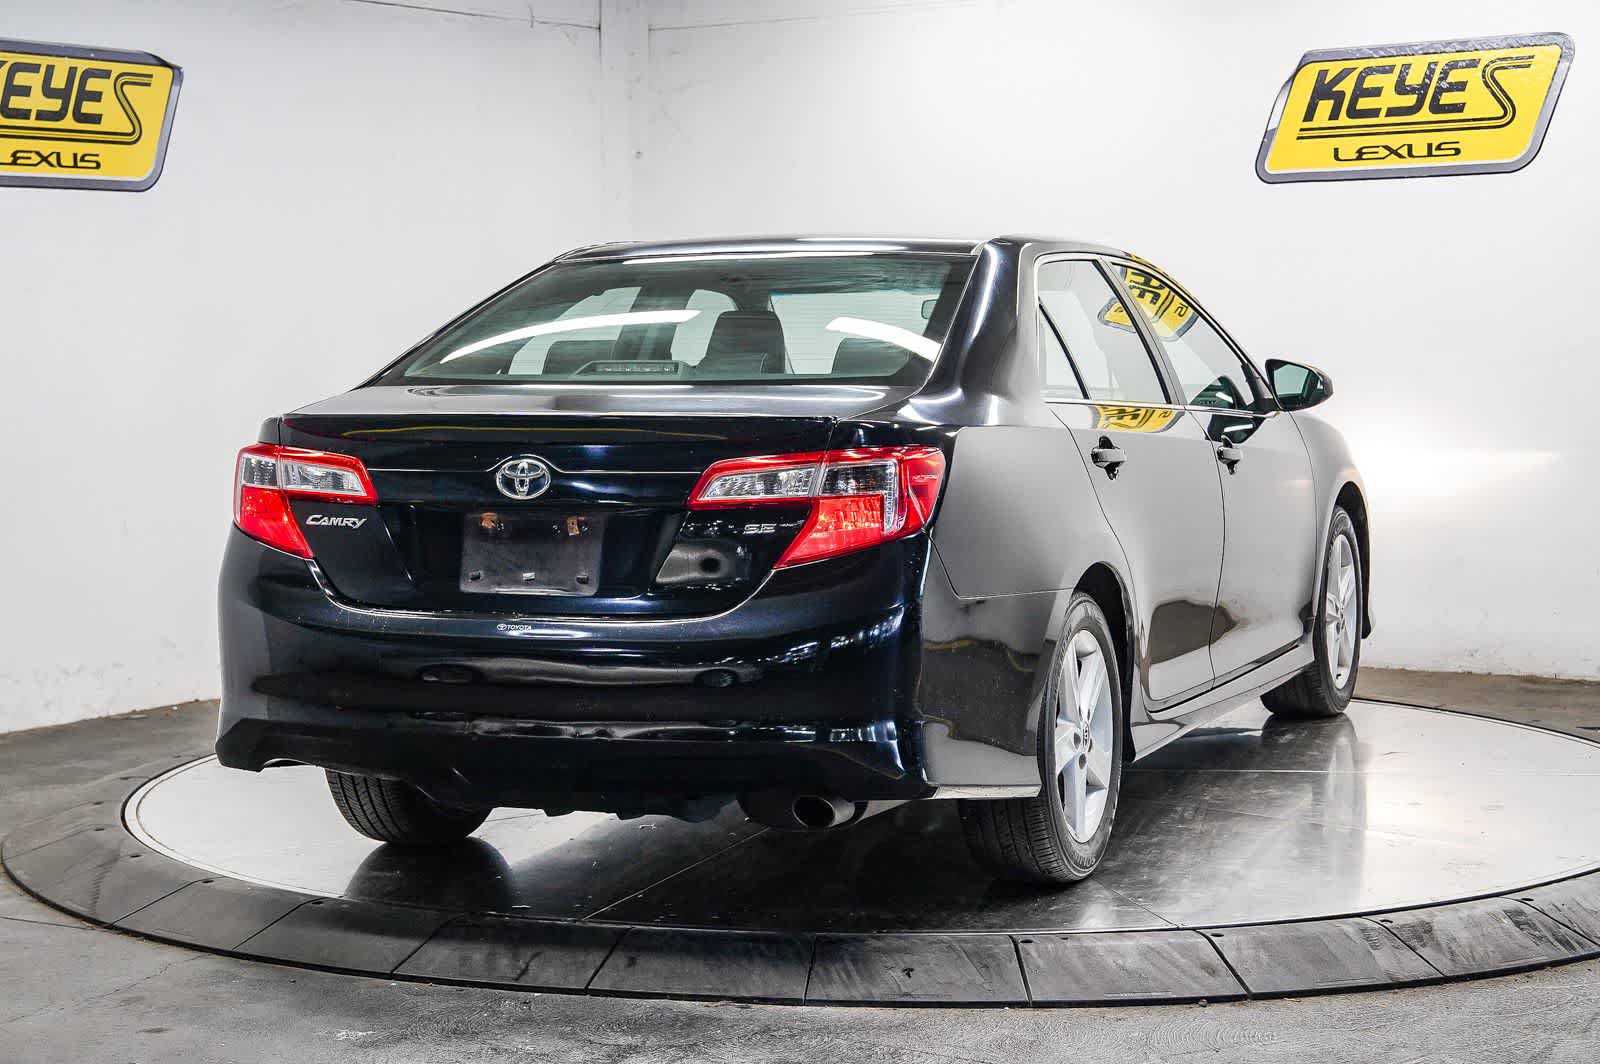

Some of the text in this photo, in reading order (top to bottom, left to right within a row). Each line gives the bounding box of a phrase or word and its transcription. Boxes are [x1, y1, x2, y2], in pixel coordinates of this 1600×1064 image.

[1300, 55, 1535, 136] KEYES
[1333, 141, 1462, 162] LEXUS
[305, 514, 368, 529] CAMRY
[743, 523, 777, 534] SE
